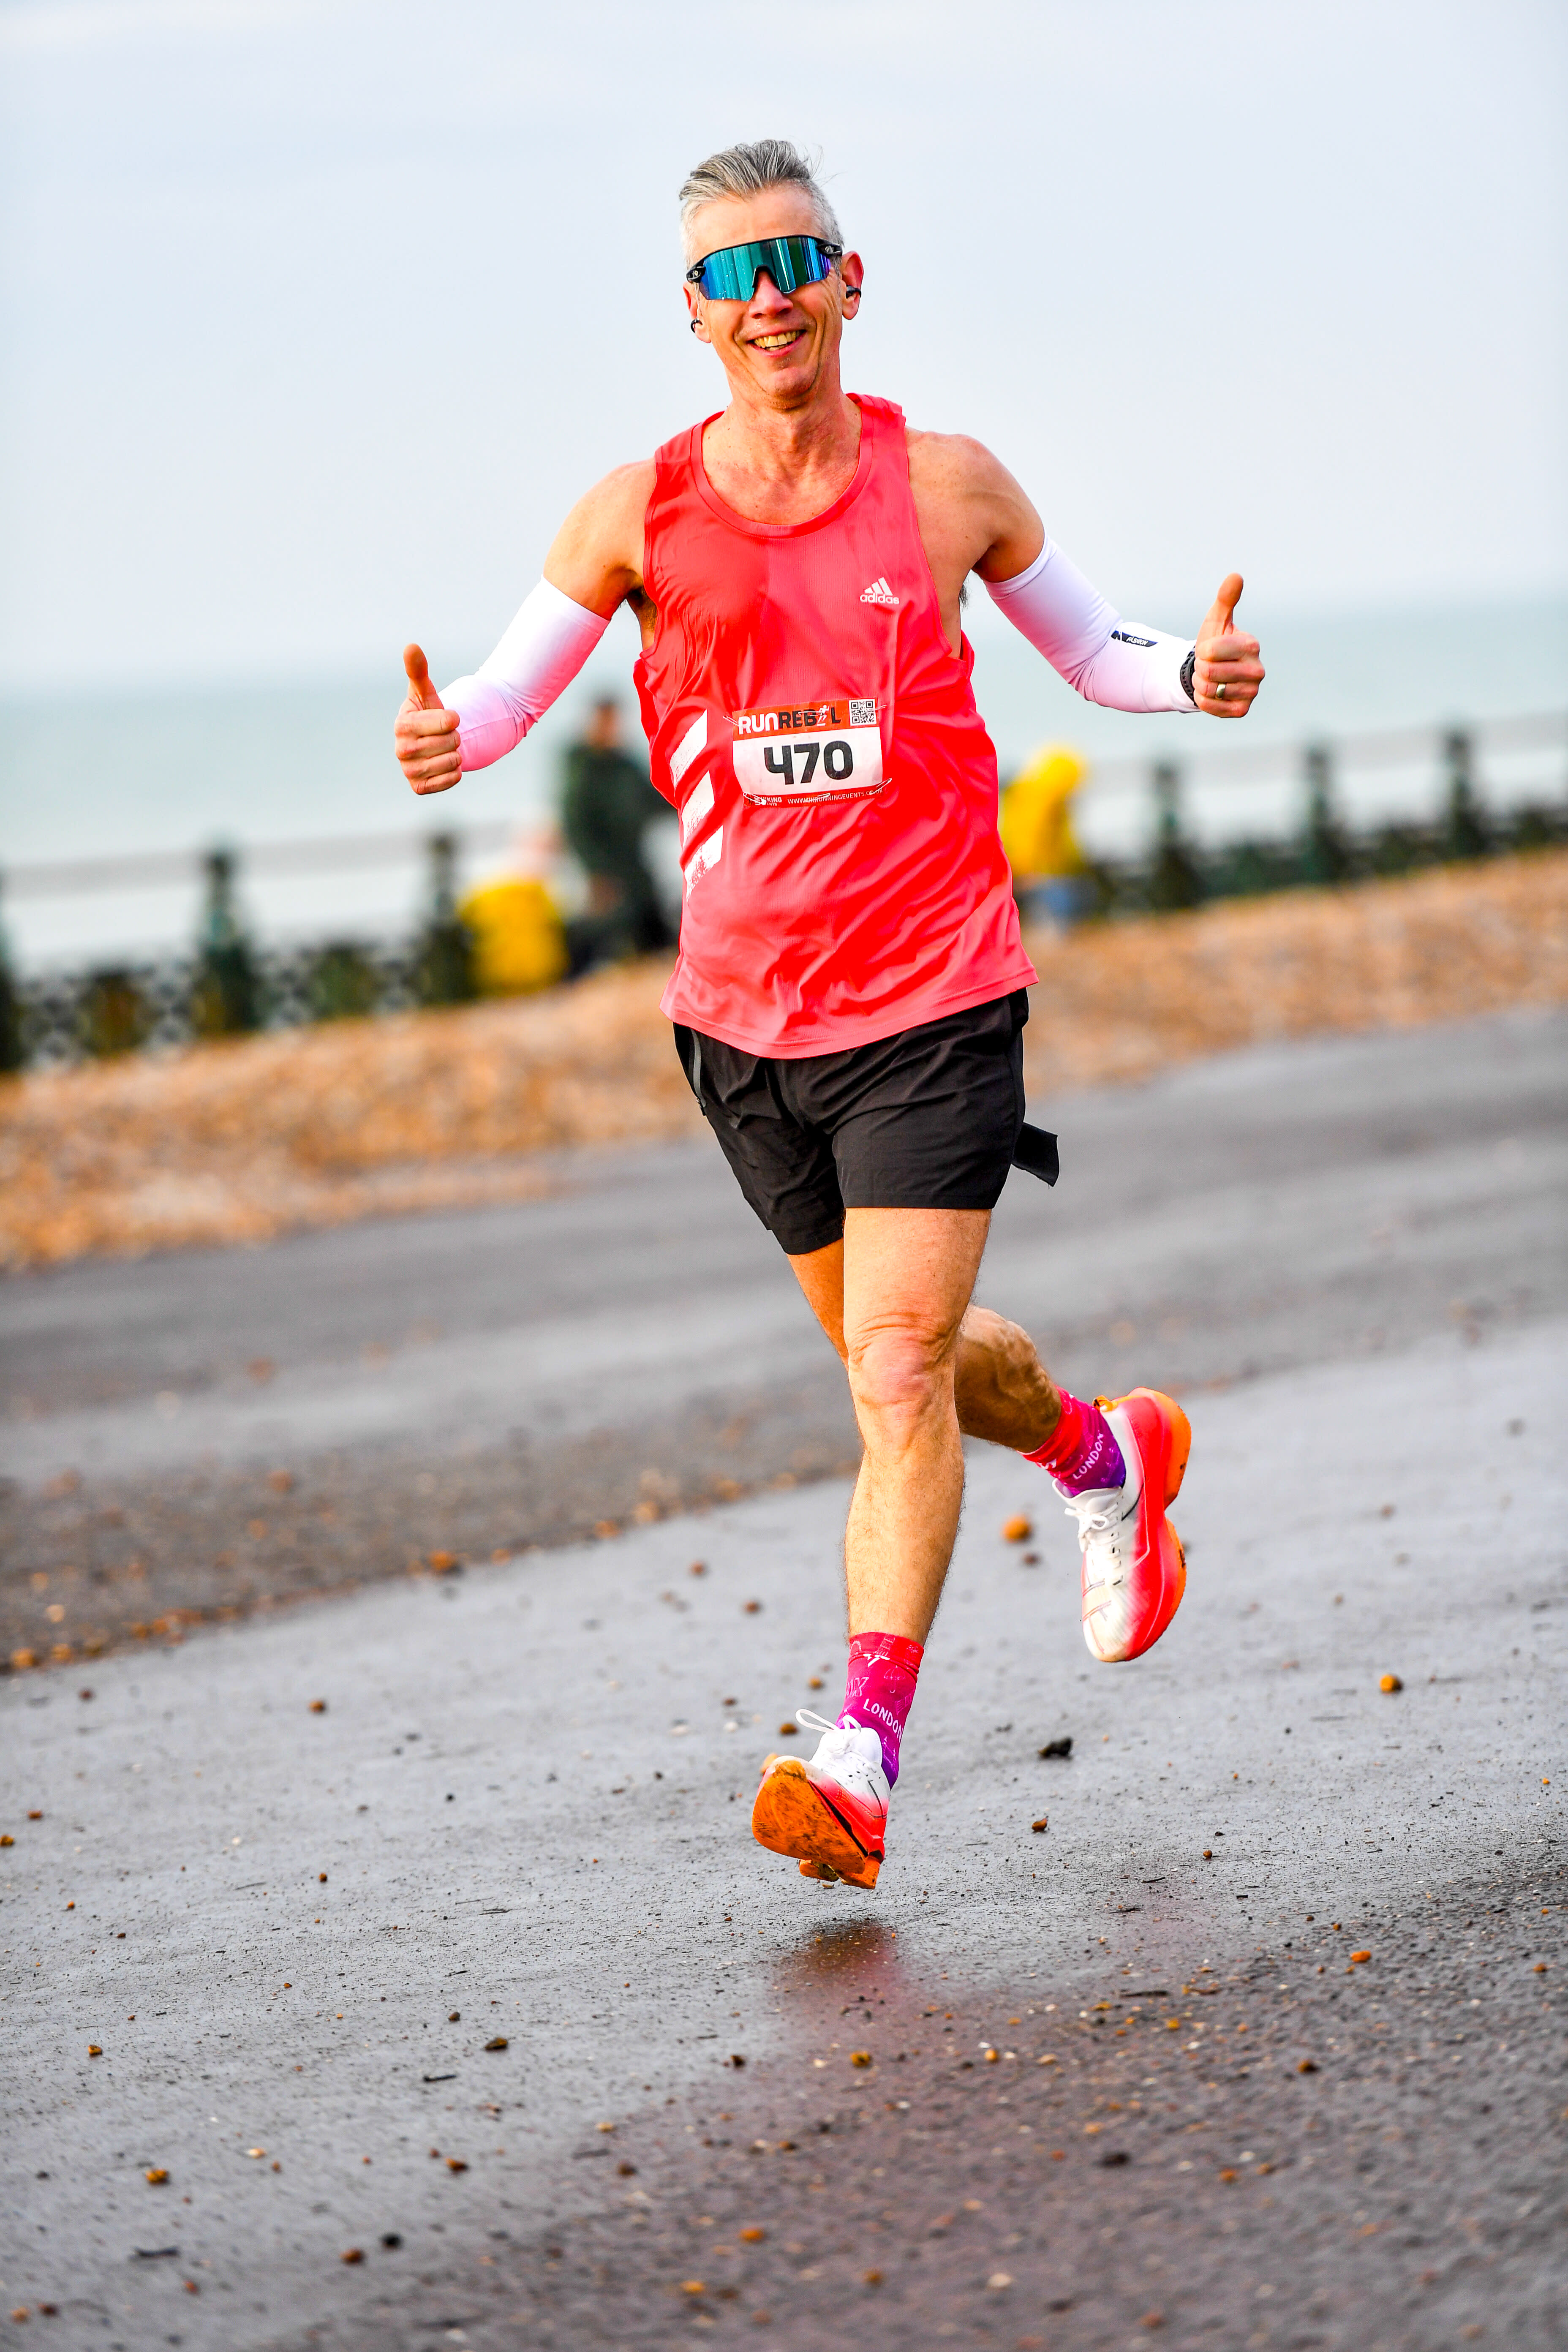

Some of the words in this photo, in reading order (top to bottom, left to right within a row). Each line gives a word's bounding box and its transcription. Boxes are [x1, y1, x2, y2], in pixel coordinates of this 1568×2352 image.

[860, 592, 900, 604] adidas
[763, 740, 854, 785] 470
[1073, 1432, 1104, 1479] LONDON
[863, 1698, 904, 1743] LONDON
